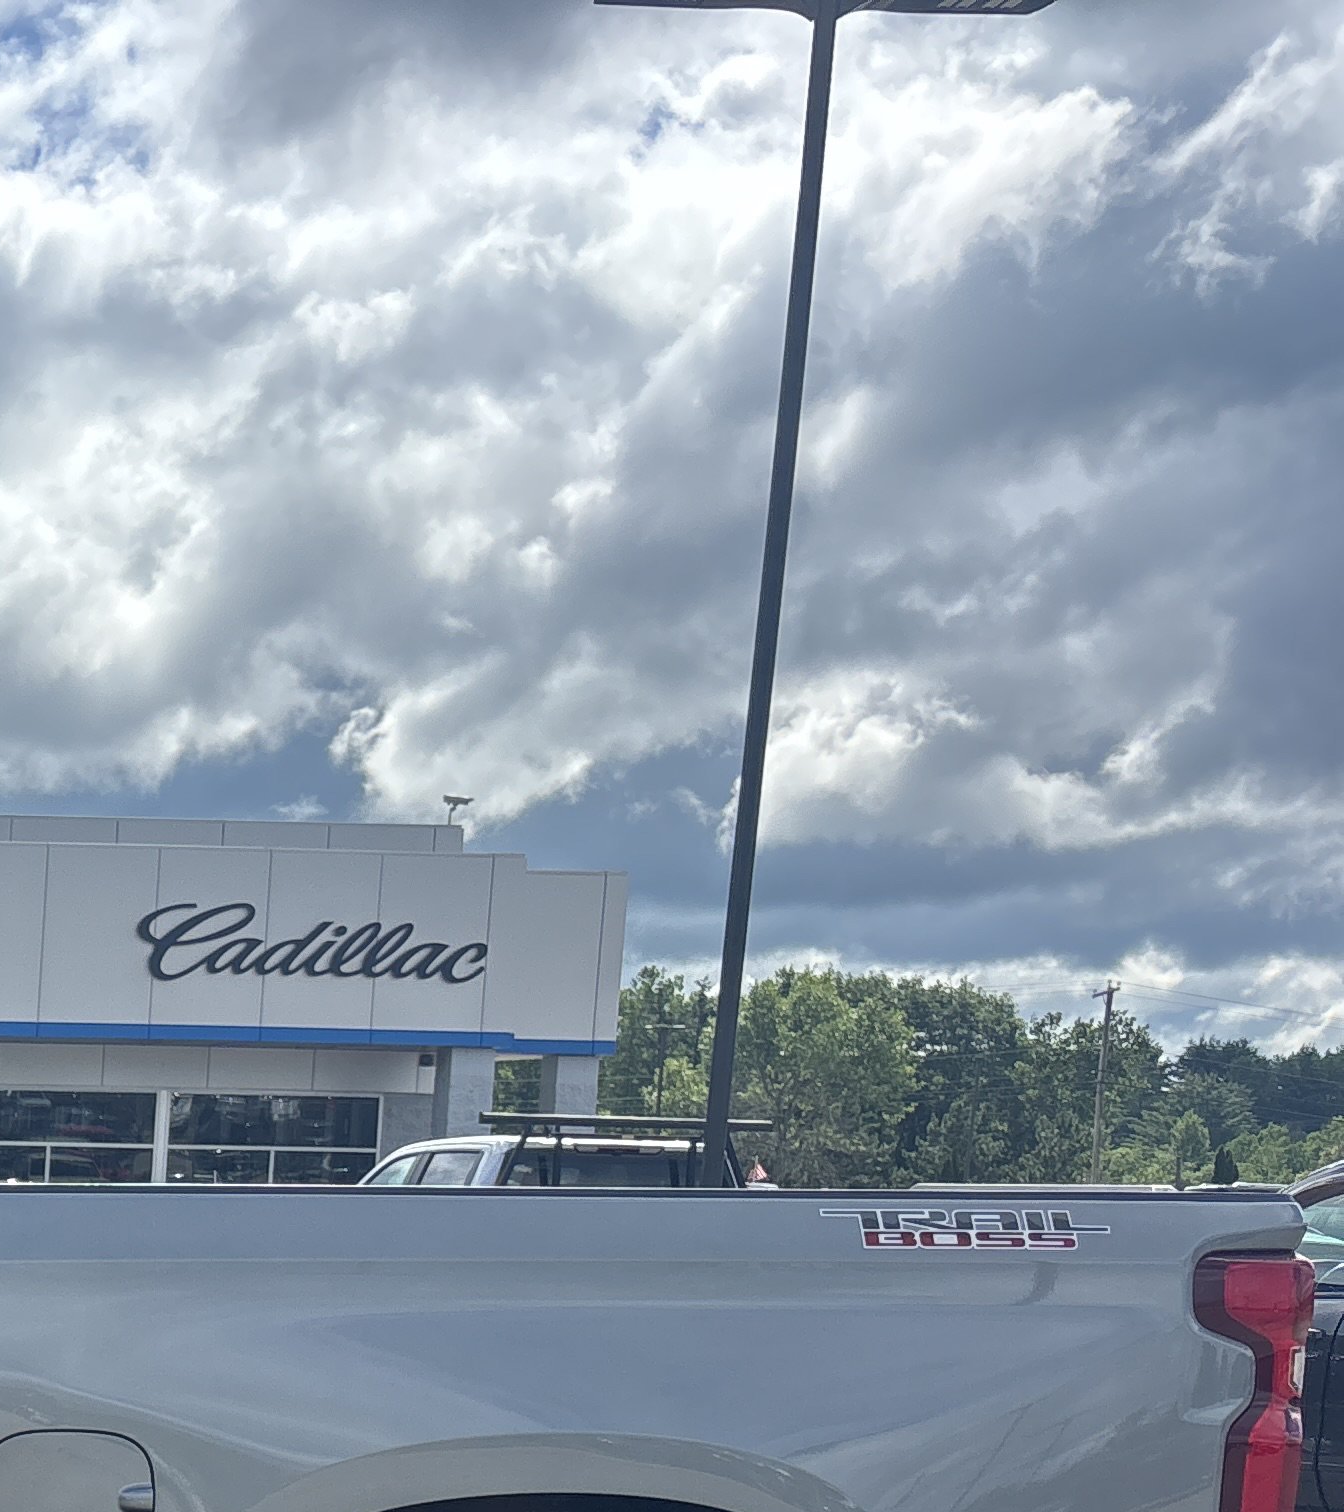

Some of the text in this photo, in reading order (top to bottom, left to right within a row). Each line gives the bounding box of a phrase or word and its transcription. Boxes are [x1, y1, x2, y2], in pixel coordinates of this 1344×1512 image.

[136, 902, 489, 984] Cadillac
[819, 1208, 1110, 1234] TRAIL
[862, 1230, 1079, 1251] BOSS
